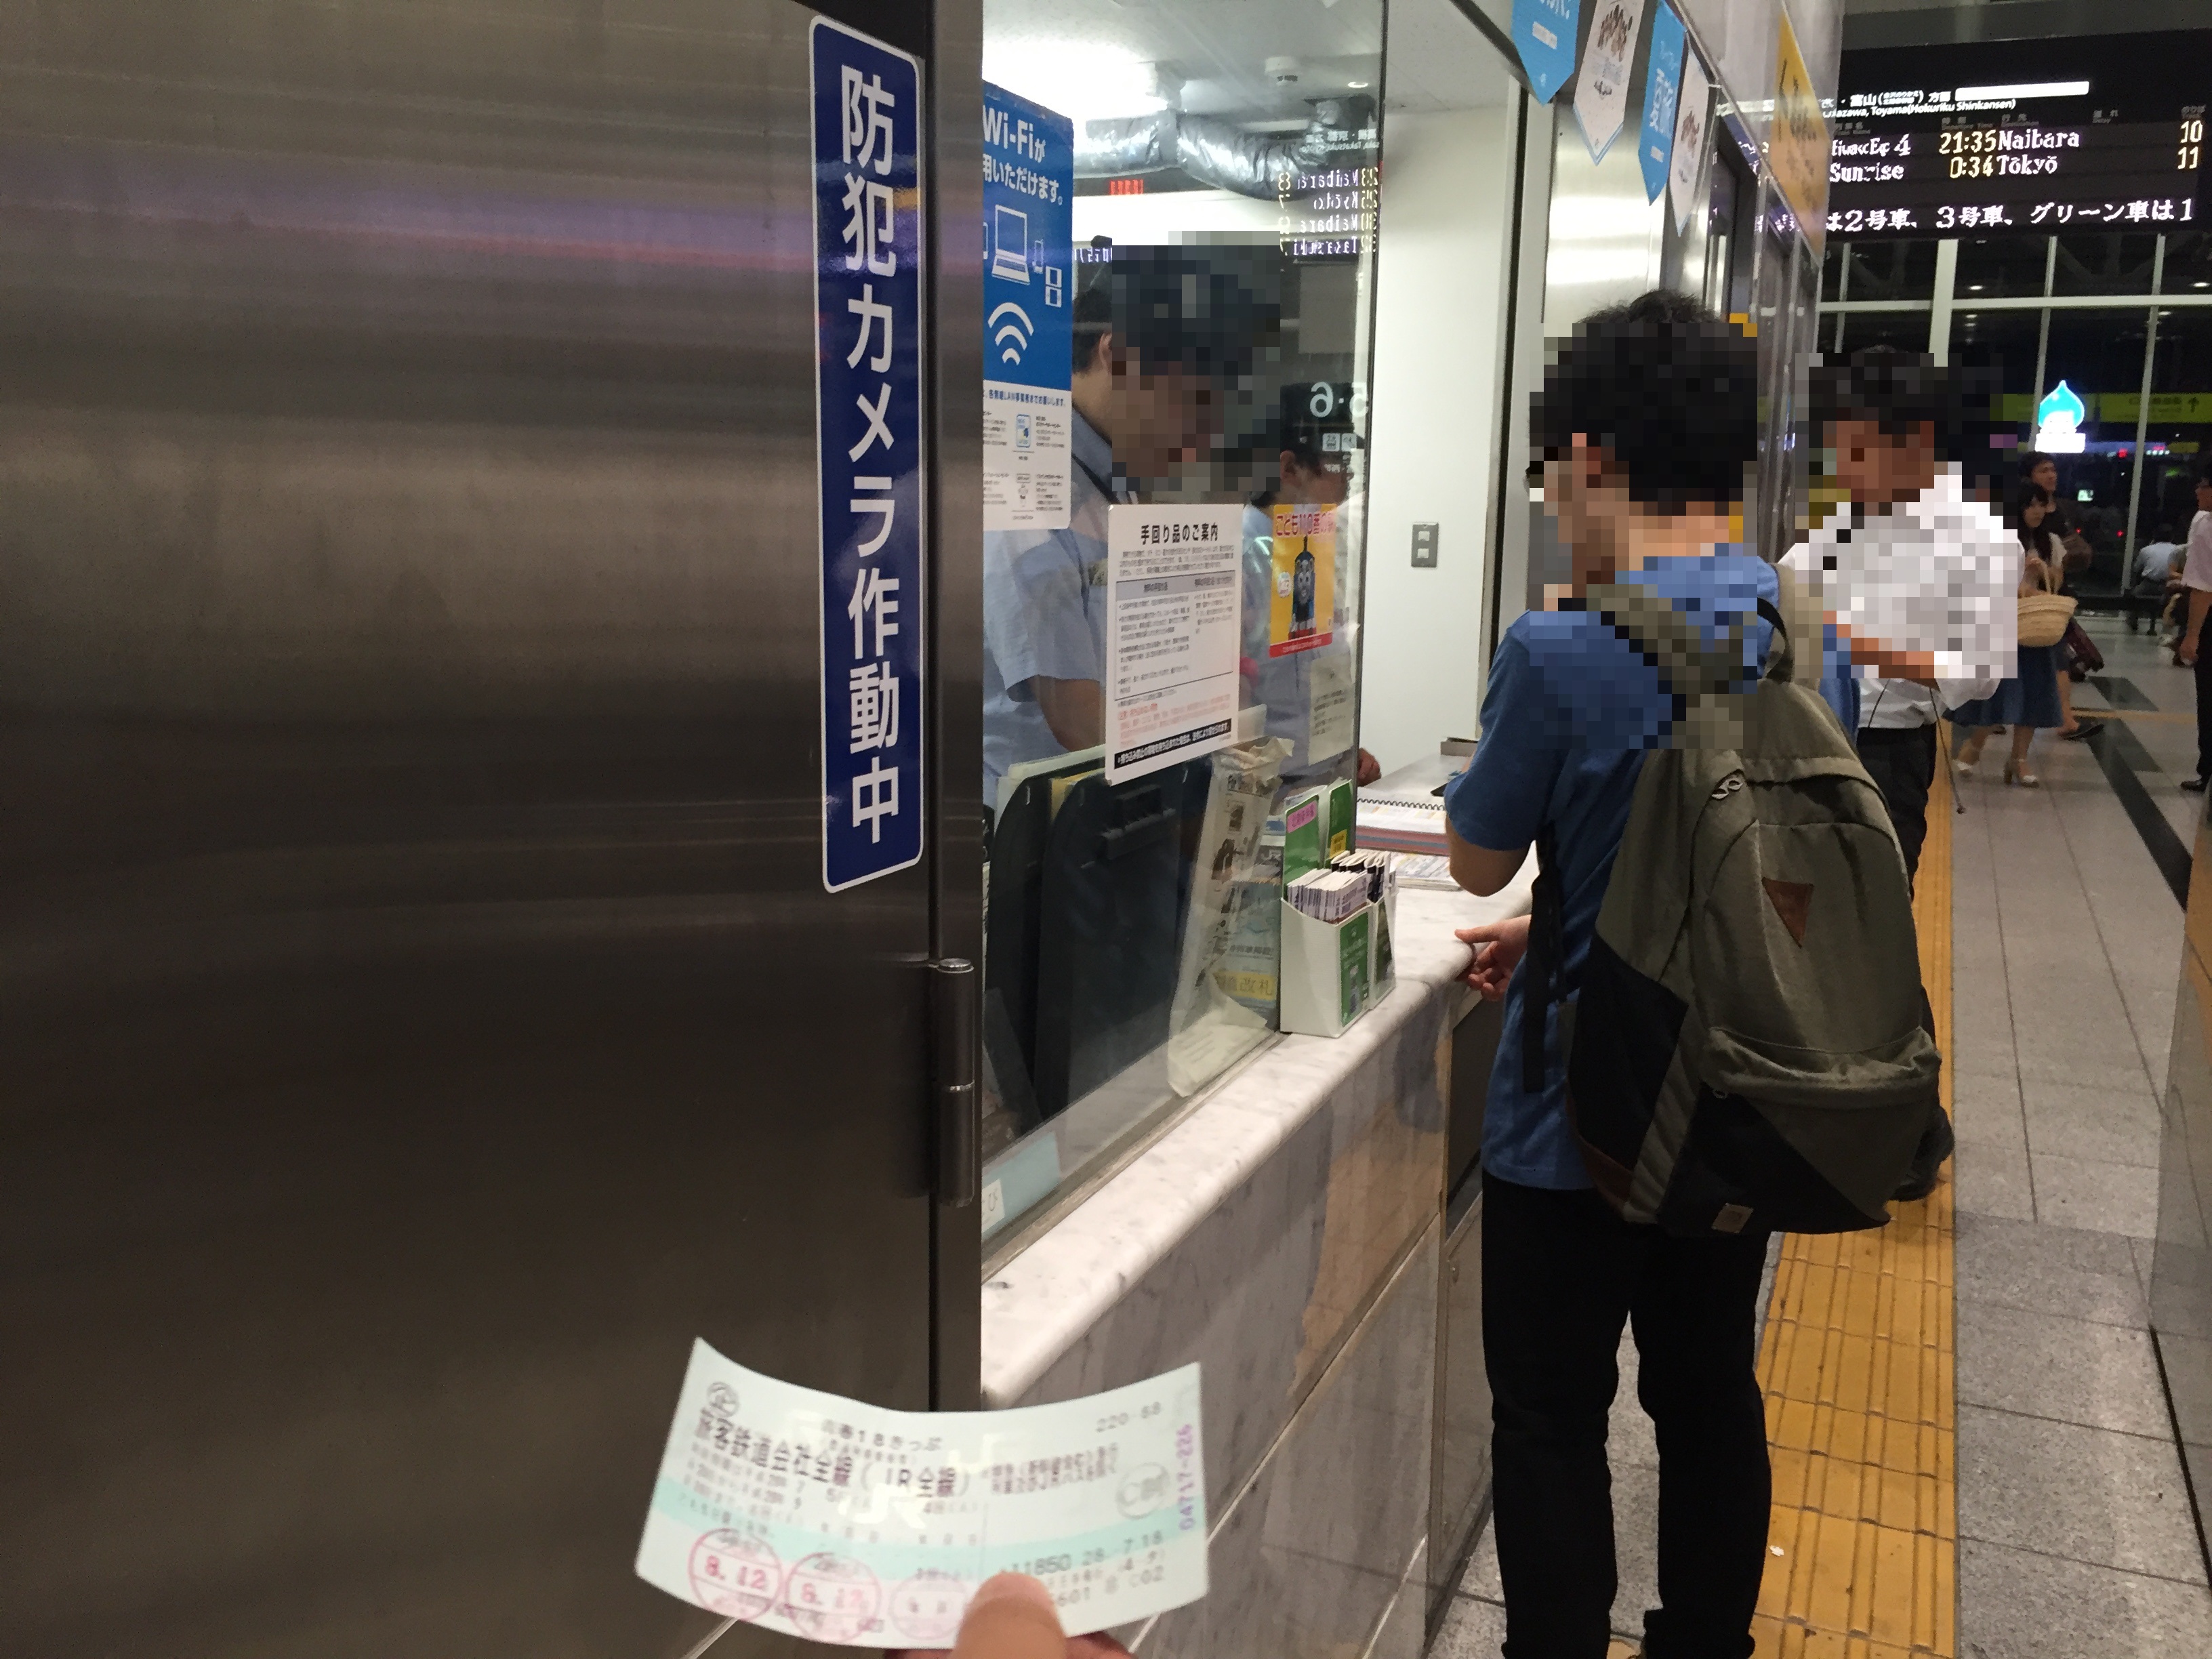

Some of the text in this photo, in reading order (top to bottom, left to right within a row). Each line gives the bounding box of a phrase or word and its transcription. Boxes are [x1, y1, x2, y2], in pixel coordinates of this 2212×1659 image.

[983, 104, 1046, 163] Wi-Fiが
[1893, 134, 1912, 157] 4
[1939, 129, 1996, 155] 21:35
[2180, 120, 2203, 144] 10
[983, 153, 1063, 206] 用いただけます。
[1949, 157, 1994, 179] 0:34
[2177, 146, 2199, 169] 11
[841, 64, 900, 844] 防犯カメラ作動中
[1141, 522, 1219, 545] 手回り品のご案内
